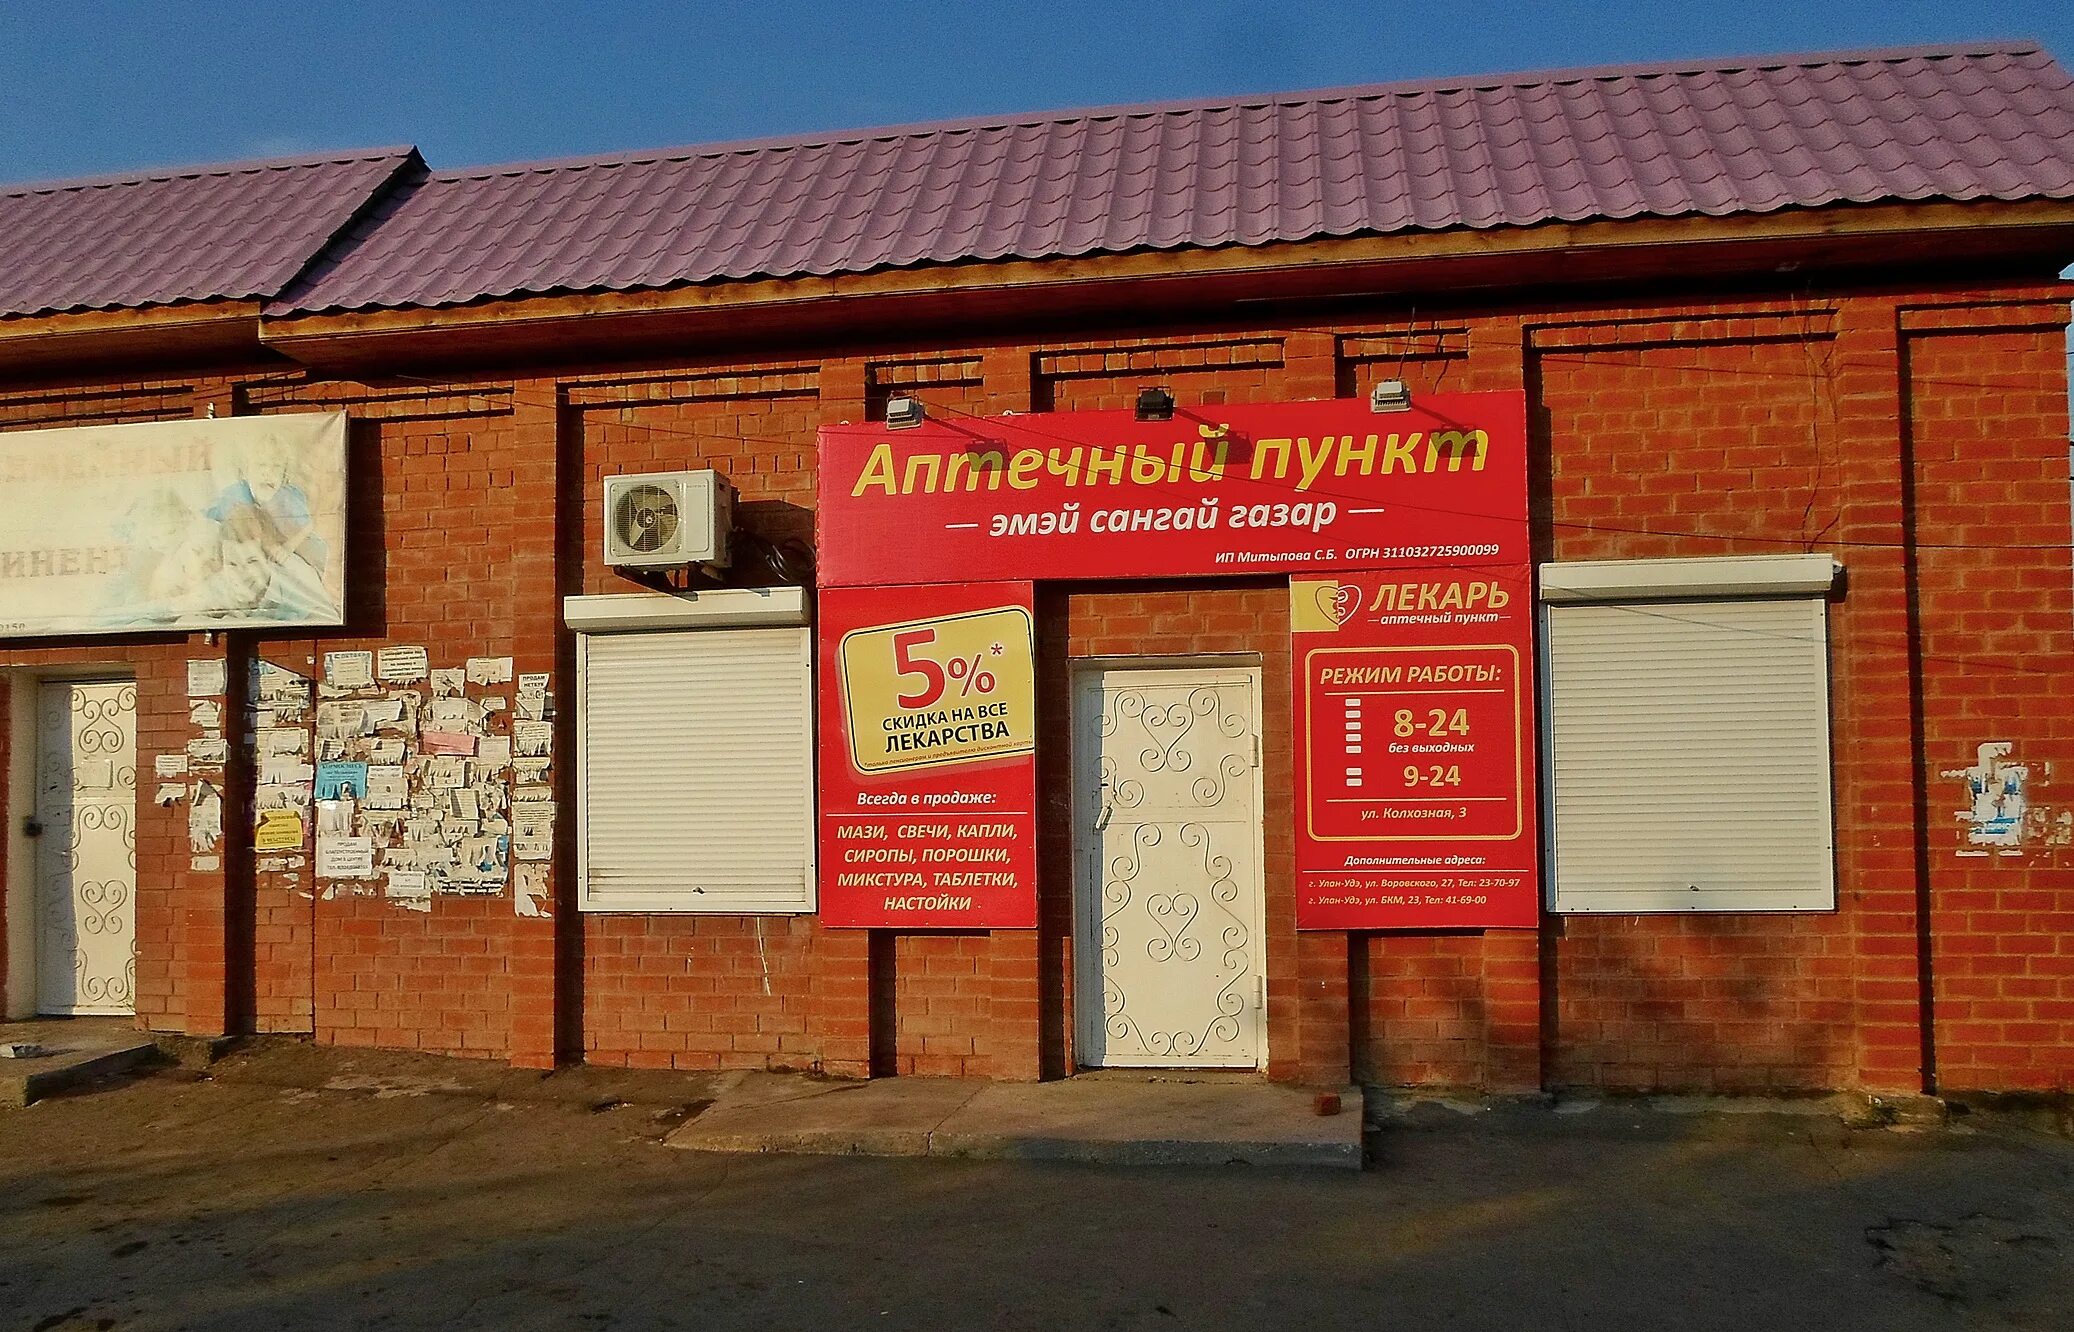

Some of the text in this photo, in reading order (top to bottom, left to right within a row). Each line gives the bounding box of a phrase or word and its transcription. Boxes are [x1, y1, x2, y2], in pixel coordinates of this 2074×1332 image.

[852, 423, 1490, 498] Аптечный пункт
[989, 499, 1338, 538] эмэй сангай газар
[1216, 544, 1499, 563] ИП Митыпова С.Б. ОГРН 311032725900099
[1370, 581, 1509, 612] ЛЕКАРЬ
[1380, 612, 1499, 625] аптечный пункт
[1320, 664, 1502, 685] РЕЖИМ РАБОТЫ:
[882, 702, 1009, 731] СКИДКА НА ВСЕ
[1394, 708, 1470, 737] 8-24
[885, 720, 1009, 753] ЛЕКАРСТВА
[1388, 741, 1475, 754] без выходных
[1403, 765, 1461, 788] 9-24
[857, 790, 997, 806] Всегда в продаже:
[1361, 807, 1467, 821] ул. Колхозная, 3
[838, 823, 1017, 841] МАЗИ, СВЕЧИ, КАПЛИ,
[845, 848, 1011, 864] СИРОПЫ, ПОРОШКИ,
[1344, 855, 1486, 866] Дополнительные адреса:
[838, 871, 1018, 889] МИКСТУРА, ТАБЛЕТКИ,
[1319, 879, 1363, 888] Улан-Удэ,
[1365, 880, 1379, 888] ул.
[1381, 879, 1439, 888] Воровского,
[1441, 879, 1455, 888] 27,
[1458, 879, 1477, 887] Тел:
[1479, 879, 1520, 887] 23-70-97
[884, 893, 972, 911] НАСТОЙКИ
[1319, 896, 1363, 906] Улан-Удэ,
[1365, 897, 1379, 906] ул.
[1381, 896, 1406, 905] БКМ,
[1408, 896, 1422, 905] 23,
[1425, 896, 1444, 904] Тел:
[1445, 896, 1486, 904] 41-69-00
